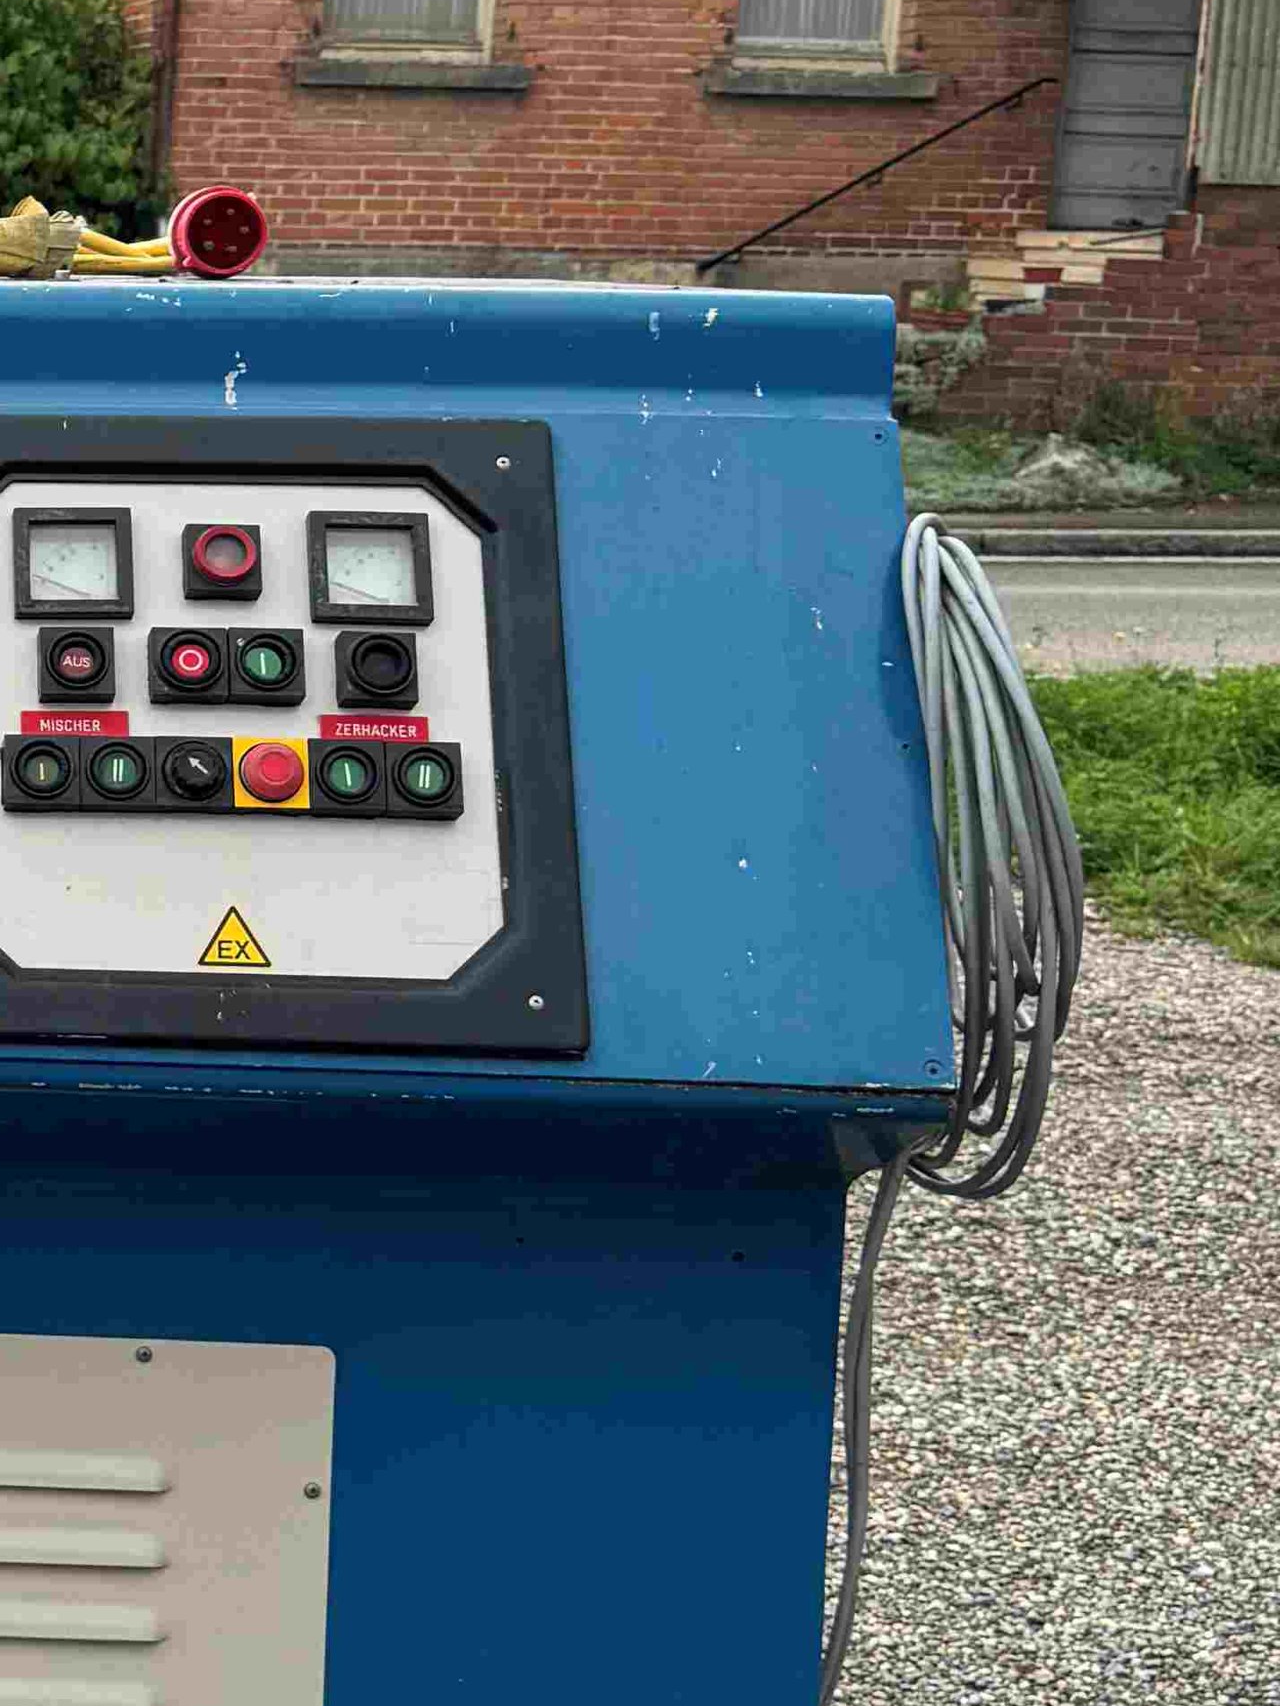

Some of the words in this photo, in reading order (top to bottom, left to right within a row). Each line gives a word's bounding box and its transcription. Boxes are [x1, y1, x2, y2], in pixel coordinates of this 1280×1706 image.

[64, 653, 91, 669] AUS
[40, 717, 101, 732] MISCHER
[335, 722, 417, 738] ZERHACKER
[217, 940, 251, 960] EX
